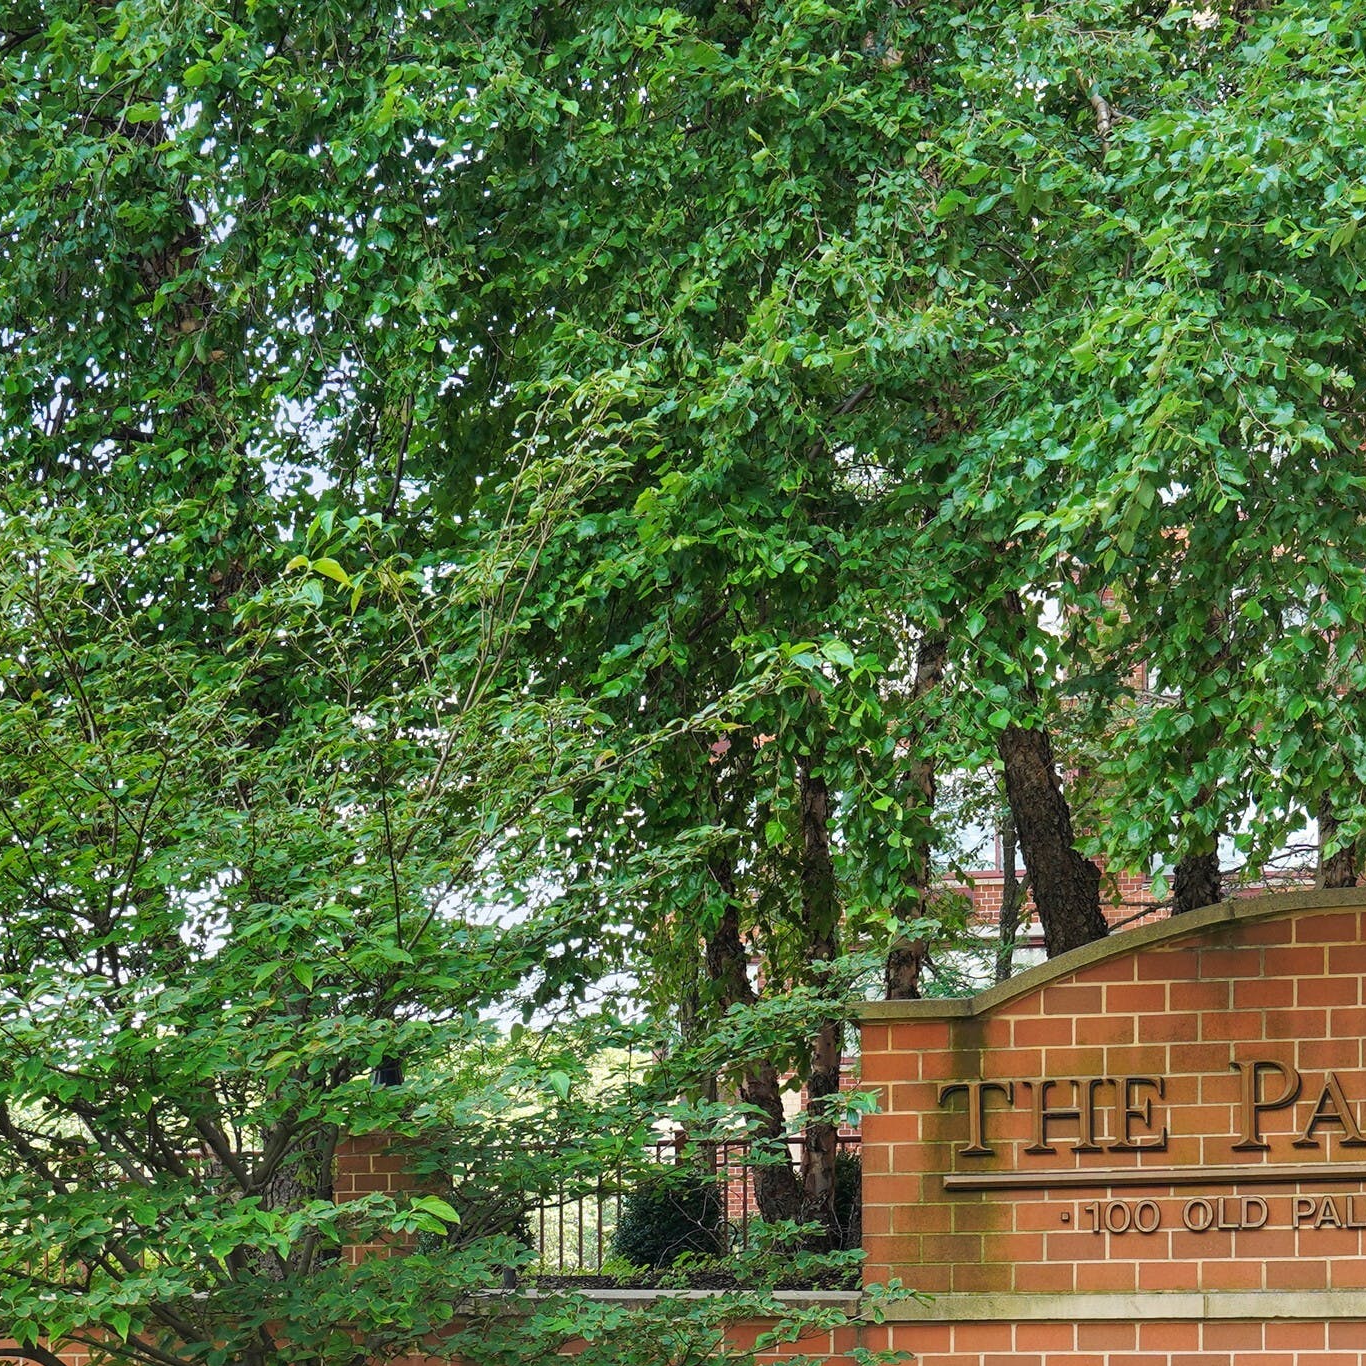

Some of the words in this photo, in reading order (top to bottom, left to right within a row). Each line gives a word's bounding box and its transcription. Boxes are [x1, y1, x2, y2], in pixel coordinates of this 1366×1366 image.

[938, 1075, 1167, 1156] THE
[1085, 1199, 1162, 1234] 100
[1182, 1195, 1269, 1233] OLD
